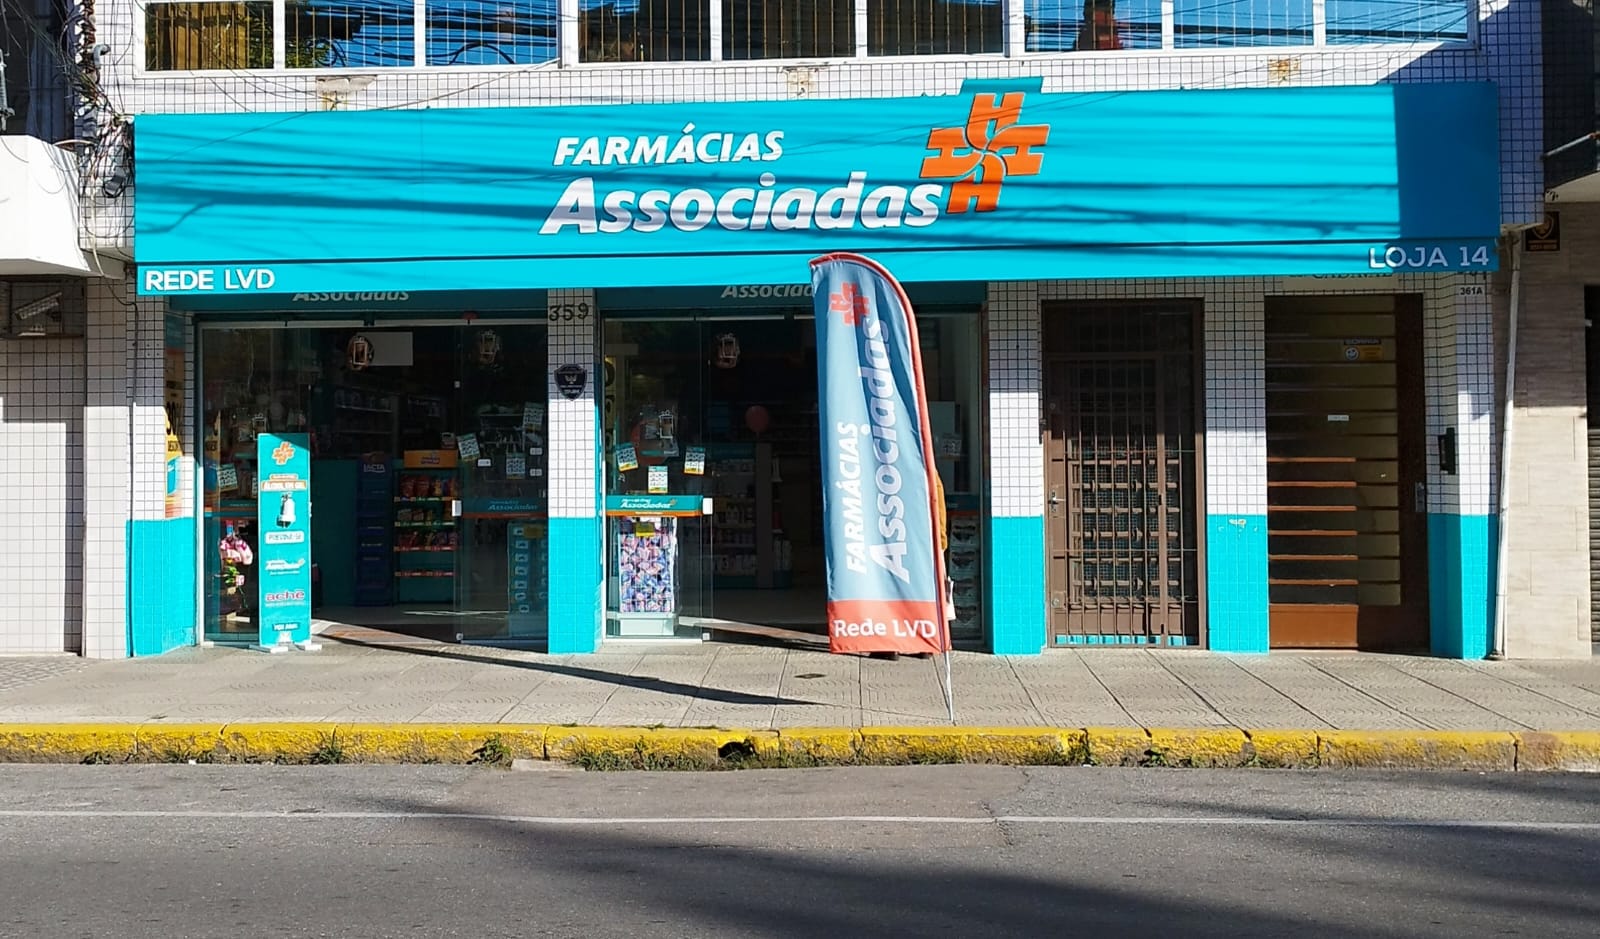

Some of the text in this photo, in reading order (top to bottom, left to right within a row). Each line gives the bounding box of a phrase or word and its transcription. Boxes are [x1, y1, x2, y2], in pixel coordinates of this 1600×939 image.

[554, 123, 784, 167] FARMÁCIAS
[539, 171, 944, 235] Associadas
[1369, 246, 1489, 269] LOJA 14
[145, 268, 275, 291] REDE LVD
[1460, 286, 1483, 296] 361A
[549, 303, 589, 321] 359
[857, 318, 910, 585] Associadas
[837, 421, 868, 576] FARMÁCIAS
[833, 618, 936, 638] Rede LVD
